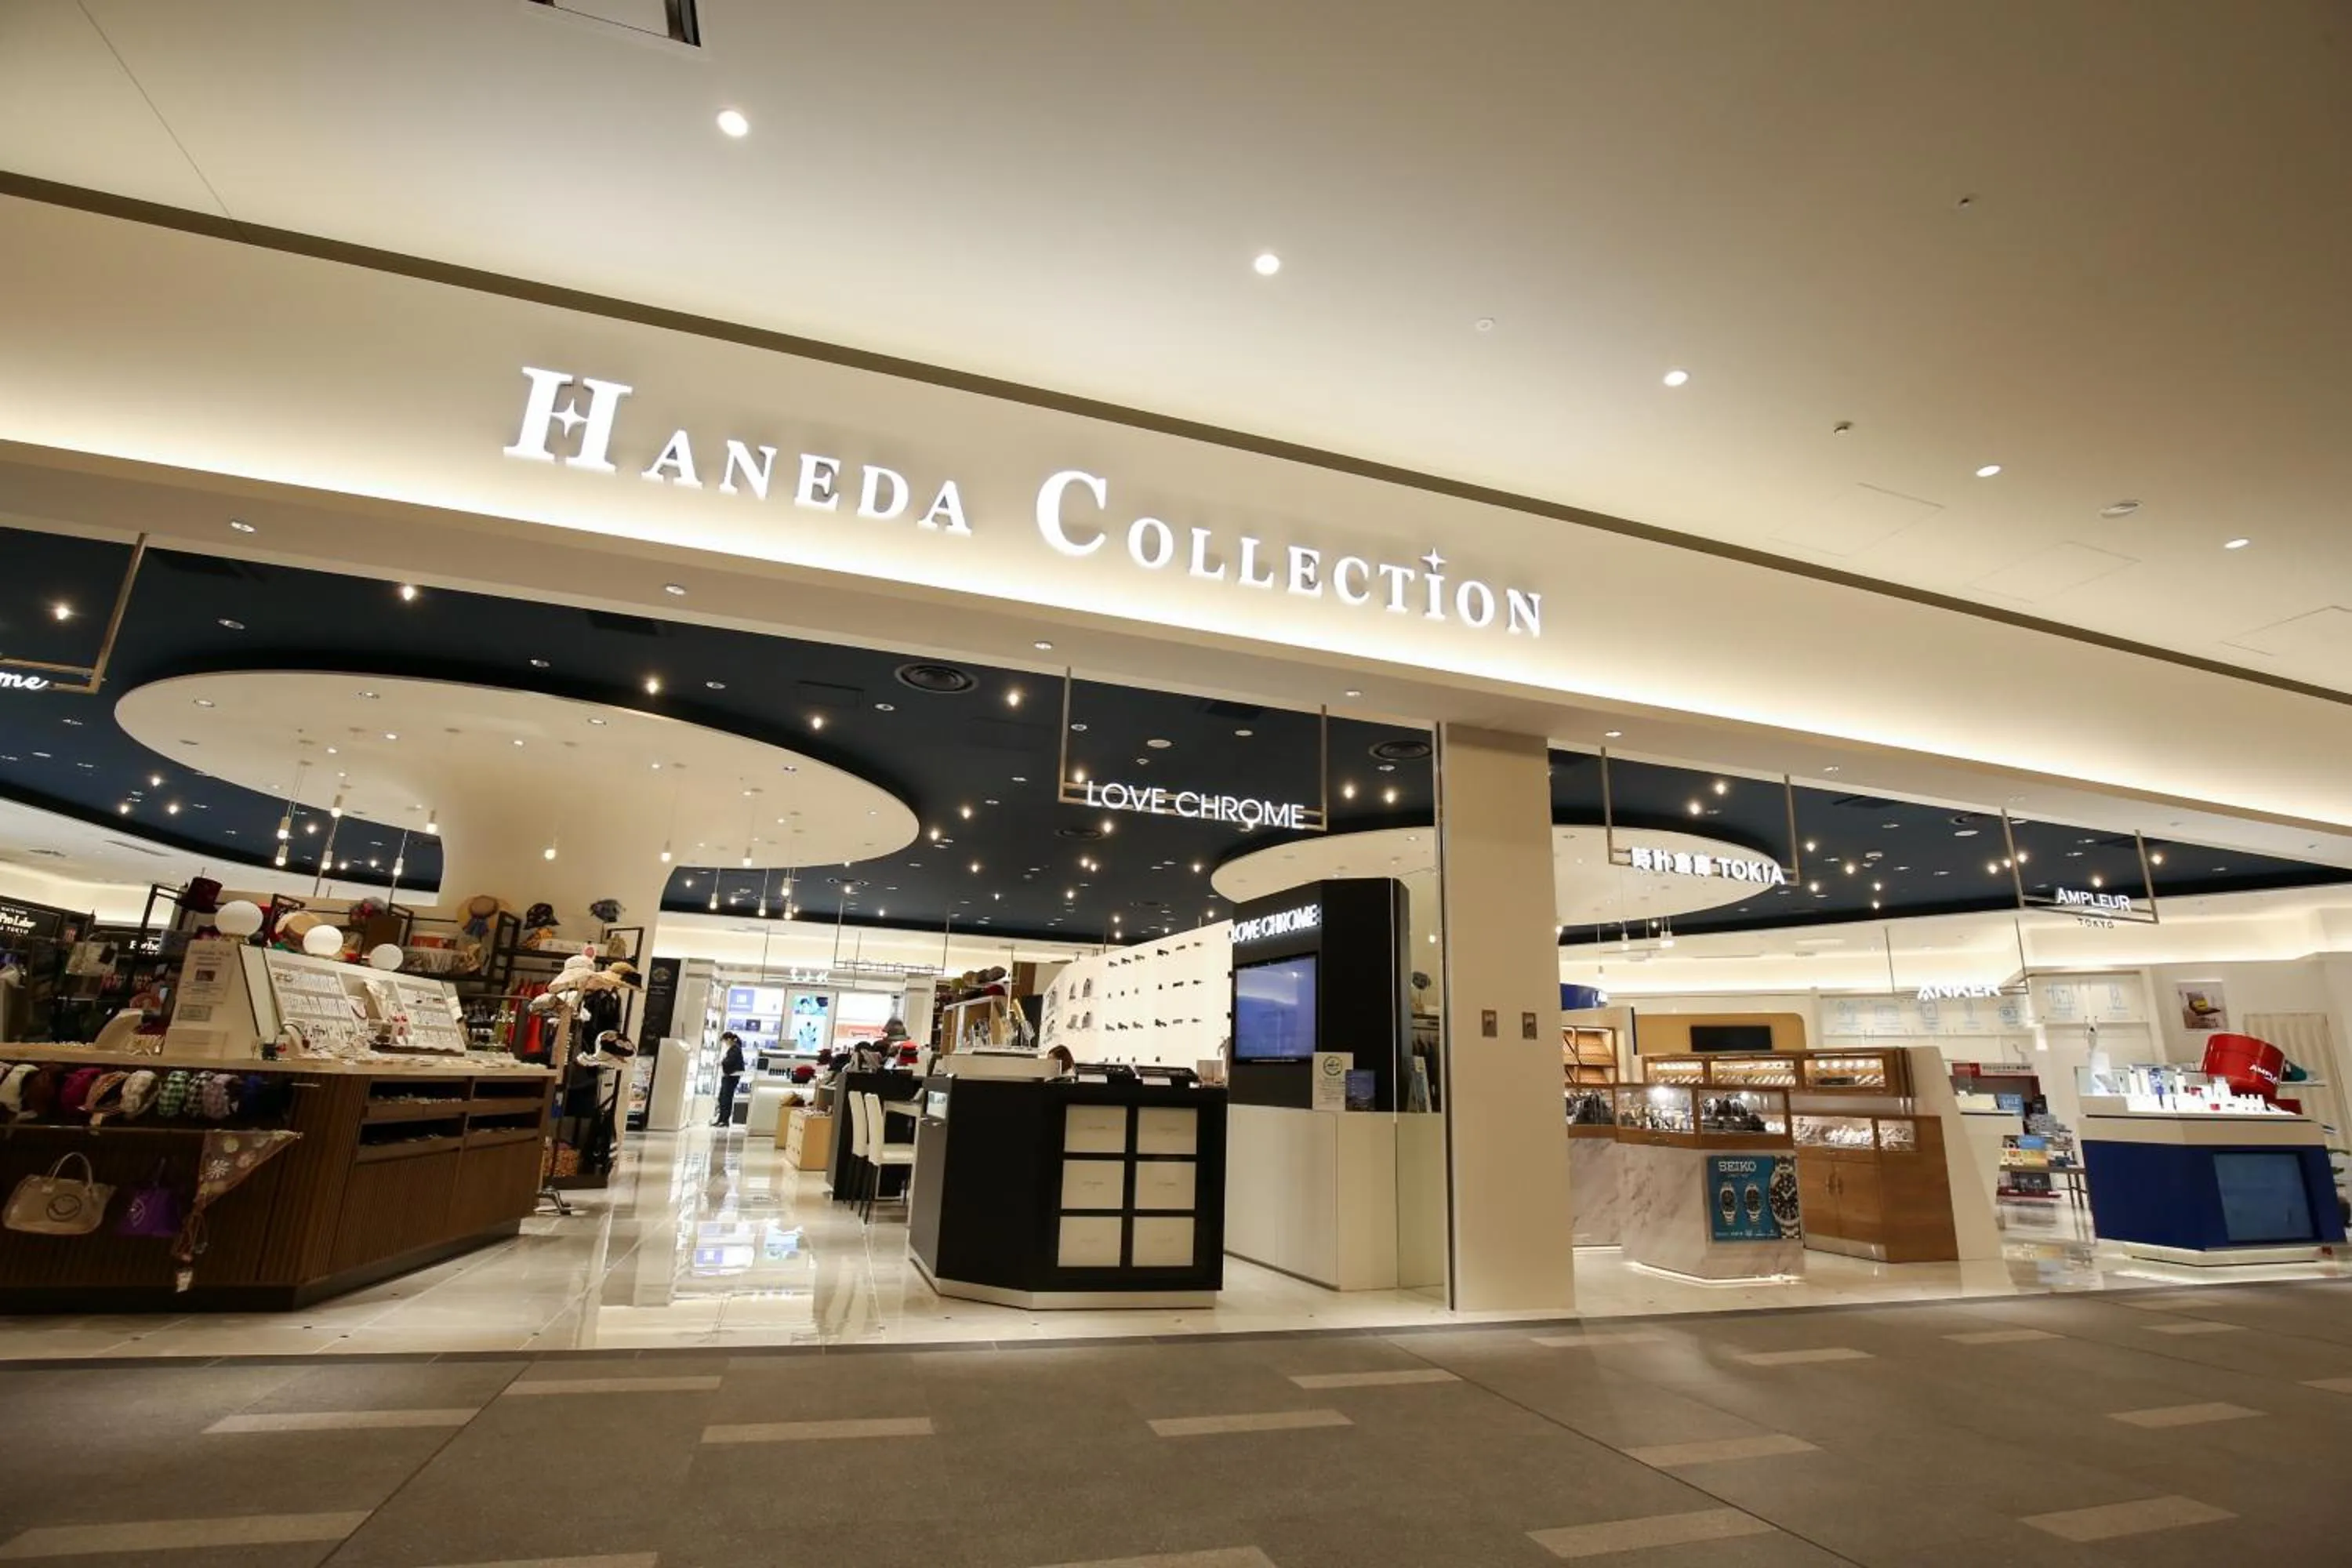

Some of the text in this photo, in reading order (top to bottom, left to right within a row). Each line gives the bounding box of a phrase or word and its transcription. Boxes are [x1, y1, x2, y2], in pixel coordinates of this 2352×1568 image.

[503, 366, 1542, 637] HANEDA COLLECTION
[1087, 780, 1305, 830] LOVE CHROME
[1716, 856, 1786, 885] TOKIA
[2056, 887, 2132, 912] AMPLEUR
[1229, 903, 1318, 943] LOVE CHROME
[2077, 916, 2115, 930] TOKYO
[1917, 982, 2002, 1001] ANKER
[1718, 1161, 1757, 1173] SEIKO
